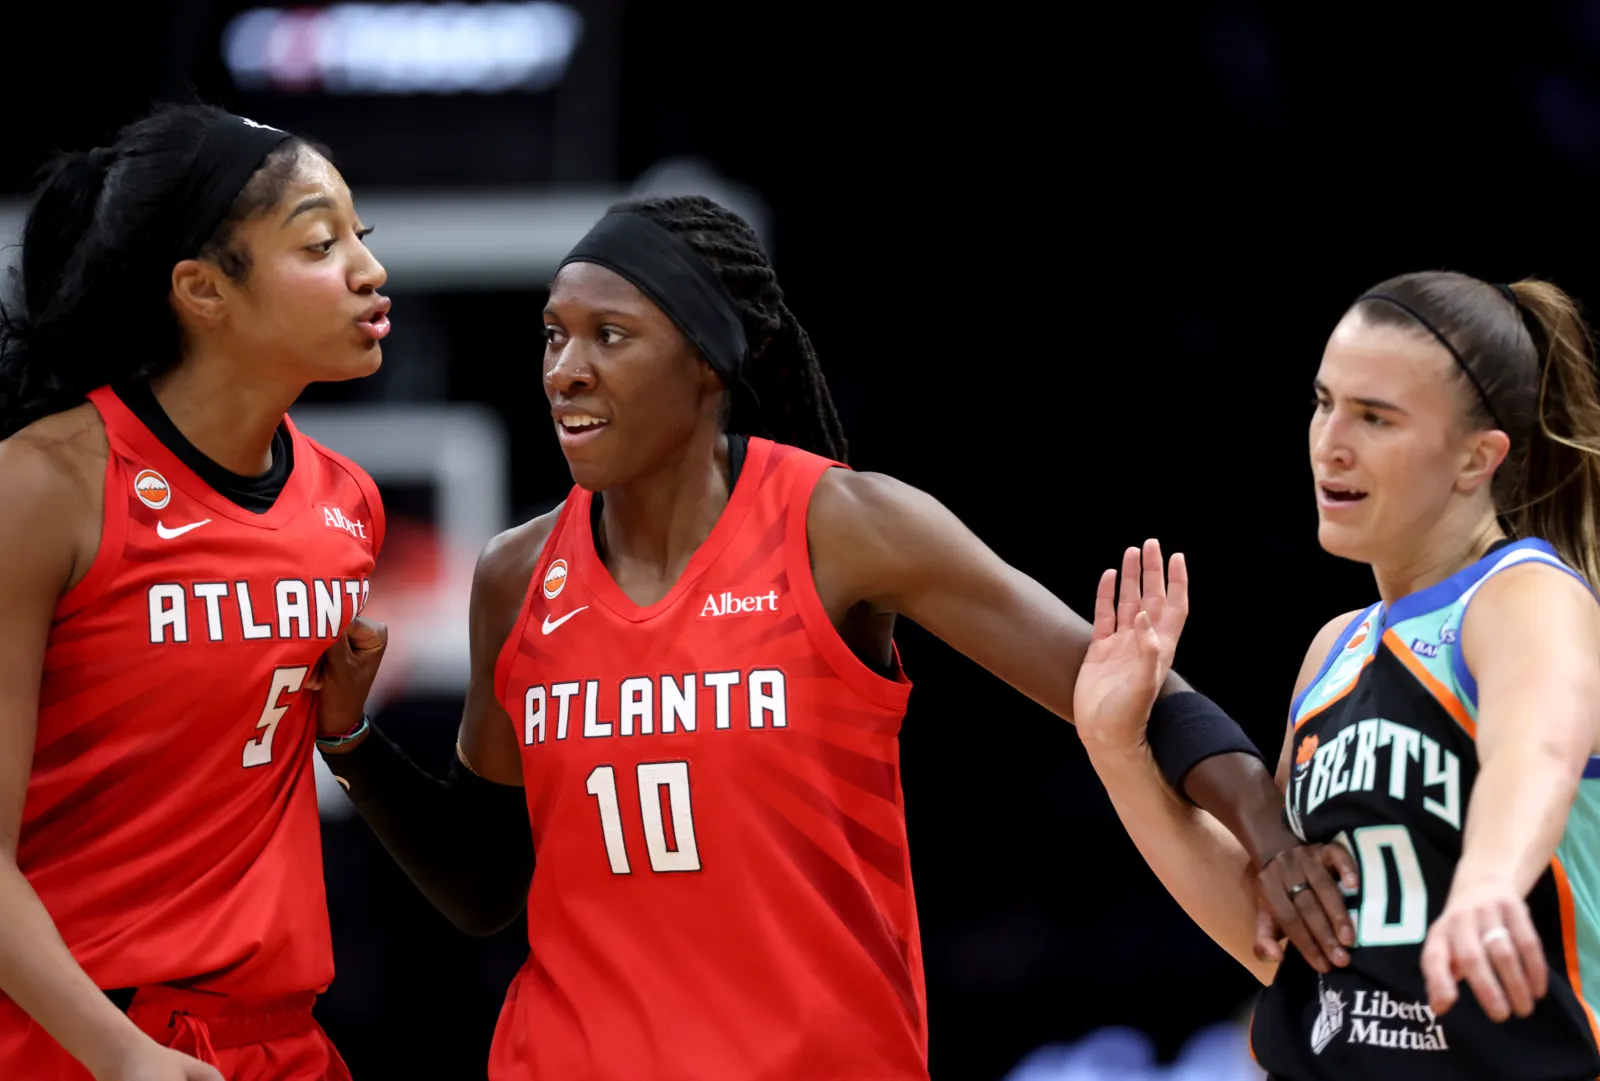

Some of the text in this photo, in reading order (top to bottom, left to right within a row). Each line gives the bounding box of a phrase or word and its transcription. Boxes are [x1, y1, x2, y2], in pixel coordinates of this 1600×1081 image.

[323, 506, 367, 539] Albert
[700, 590, 778, 617] Albert
[242, 665, 309, 768] 5
[523, 668, 788, 747] ATLANTA
[585, 760, 702, 875] 10
[1333, 824, 1428, 948] 0
[1347, 1018, 1449, 1051] Mutual
[1350, 990, 1437, 1033] Liberty
